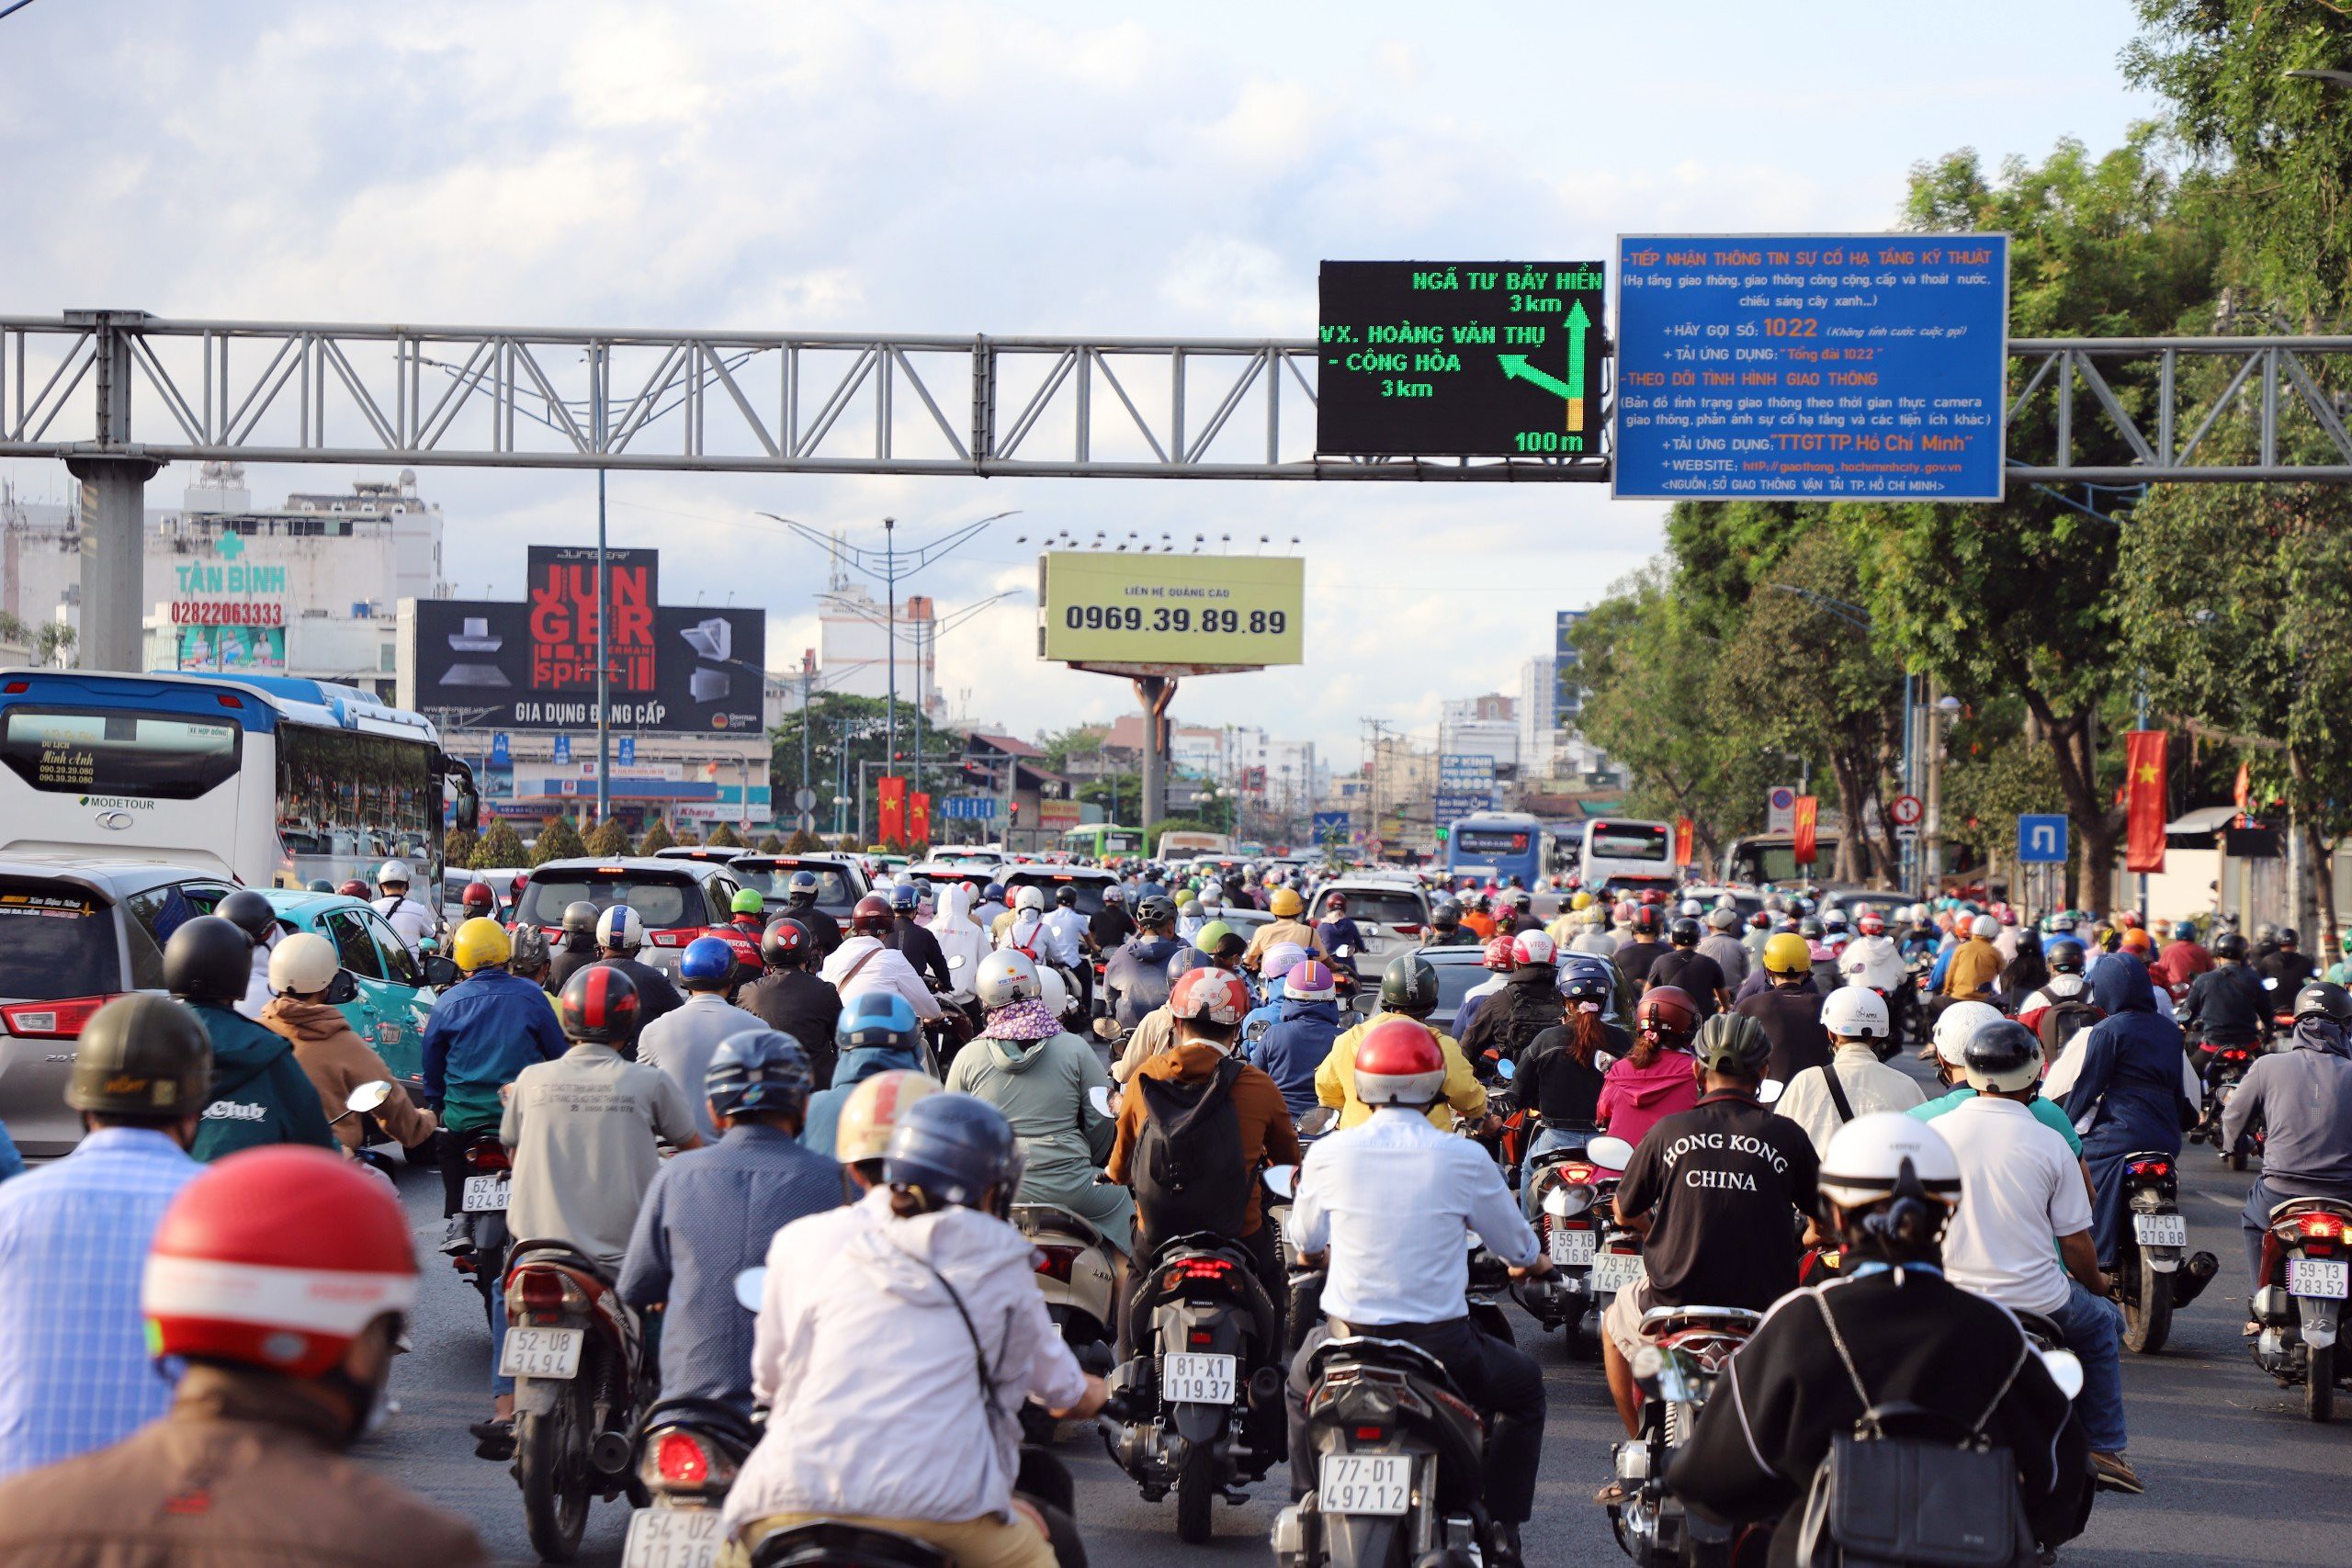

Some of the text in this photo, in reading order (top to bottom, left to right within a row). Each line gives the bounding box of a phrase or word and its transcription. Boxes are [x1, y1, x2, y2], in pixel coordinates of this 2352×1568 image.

[1666, 250, 1706, 267] NHẬN
[1714, 250, 1761, 265] THÔNG
[1767, 252, 1789, 265] TIN
[1796, 252, 1817, 267] SỰ
[1823, 247, 1843, 265] CỐ
[1849, 252, 1870, 267] HẠ
[1879, 247, 1915, 265] TẦNG
[1922, 249, 1941, 265] KỸ
[1948, 248, 1992, 266] THUẬT
[1412, 266, 1459, 290] NGÃ
[1467, 271, 1498, 291] TƯ
[1624, 275, 1643, 288] (Hạ
[1647, 274, 1672, 288] tầng
[1679, 276, 1702, 288] giao
[1746, 276, 1768, 288] giao
[1772, 275, 1804, 288] thông
[1810, 274, 1838, 287] công
[1876, 272, 1896, 288] cấp
[1903, 273, 1916, 285] và
[1921, 274, 1949, 285] thoát
[1739, 294, 1770, 306] chiếu
[1775, 294, 1803, 309] sáng
[1808, 296, 1828, 309] cây
[1368, 321, 1444, 344] HOÀNG
[1452, 321, 1496, 344] VĂN
[1503, 326, 1545, 349] THỤ
[1707, 318, 1967, 338] GỌI SỐ: 1022 (Không tính cước cuộc gọi)
[1345, 348, 1461, 375] CỘNG HÒA
[1701, 345, 1729, 360] ỨNG
[1736, 348, 1778, 363] DỤNG:
[1821, 348, 1839, 360] đài
[1672, 369, 1695, 385] DÕI
[1702, 368, 1735, 385] TÌNH
[1742, 368, 1777, 385] HÌNH
[1786, 372, 1820, 385] GIAO
[1828, 371, 1878, 385] THÔNG
[1621, 394, 1982, 410] (Bản đồ tình trạng giao thông theo thời gian thực camera
[1626, 414, 1650, 427] giao
[1696, 412, 1725, 427] phản
[1731, 413, 1753, 424] ánh
[1758, 414, 1775, 427] sự
[1780, 412, 1795, 424] cố
[1799, 414, 1814, 426] hạ
[1819, 412, 1845, 427] tầng
[1851, 413, 1865, 424] và
[1871, 412, 1894, 424] các
[1900, 412, 1921, 427] tiện
[1929, 412, 1948, 424] ích
[1954, 413, 1991, 425] khác)
[1697, 438, 1725, 450] ỨNG
[1732, 439, 1774, 454] DỤNG:
[1857, 433, 1880, 451] Hồ
[1885, 431, 1914, 450] Chí
[1713, 476, 1727, 490] SỞ
[1732, 479, 1756, 490] GIAO
[1761, 477, 1796, 490] THÔNG
[1803, 479, 1823, 492] VẬN
[1829, 476, 1844, 491] TẢI
[1850, 479, 1866, 491] TP.
[1870, 476, 1883, 491] HỒ
[1888, 476, 1905, 491] CHÍ
[175, 560, 285, 592] TÂN BÌNH
[1125, 585, 1230, 598] LIÊN HỆ QUẢNG CÁO
[172, 602, 282, 626] 02822063333
[1066, 605, 1285, 633] 0969.39.89.89
[515, 700, 666, 726] GIA DỤNG ĐNG CẤP
[40, 750, 66, 765] Minh
[91, 797, 154, 809] MODETOUR
[681, 808, 715, 818] Khang
[200, 1100, 268, 1122] Club
[1663, 1134, 1788, 1174] HONG KONG
[1686, 1170, 1758, 1190] CHINA
[2143, 1216, 2177, 1229] 77-C1
[1559, 1234, 1594, 1247] 59-XB
[2141, 1231, 2185, 1245] 378.88
[1602, 1258, 1640, 1274] 79-H2
[2300, 1263, 2339, 1279] 59-Y3
[2294, 1279, 2345, 1296] 283.52
[518, 1332, 571, 1351] 52-U8
[514, 1354, 566, 1374] 3494
[1177, 1358, 1224, 1378] 81-X1
[1171, 1379, 1231, 1400] 119.37
[1338, 1459, 1394, 1483] 77-D1
[1327, 1485, 1404, 1509] 497.12
[646, 1515, 717, 1540] 54-U2
